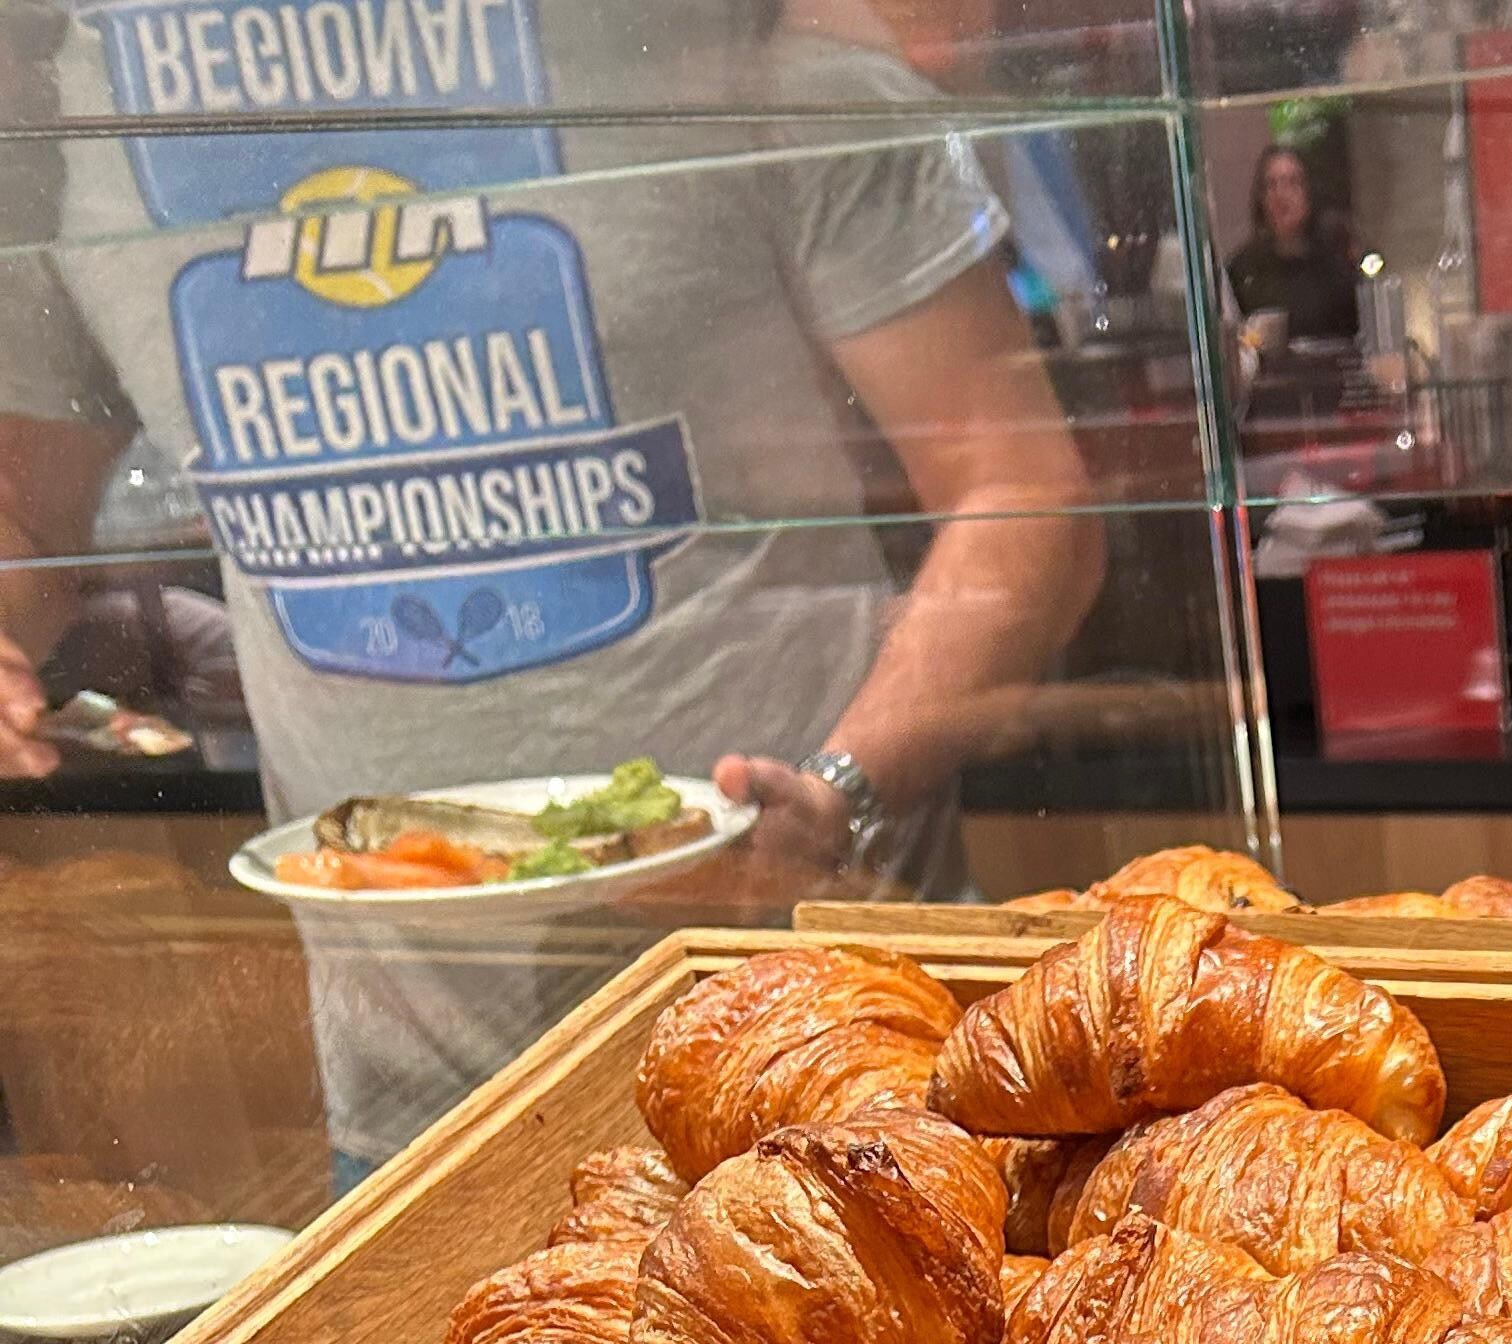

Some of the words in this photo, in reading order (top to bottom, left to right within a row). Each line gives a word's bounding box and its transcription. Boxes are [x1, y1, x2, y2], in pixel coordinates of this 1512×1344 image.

[215, 328, 588, 463] REGIONAL
[211, 448, 657, 567] CHAMPIONSHIPS
[359, 616, 399, 657] 20
